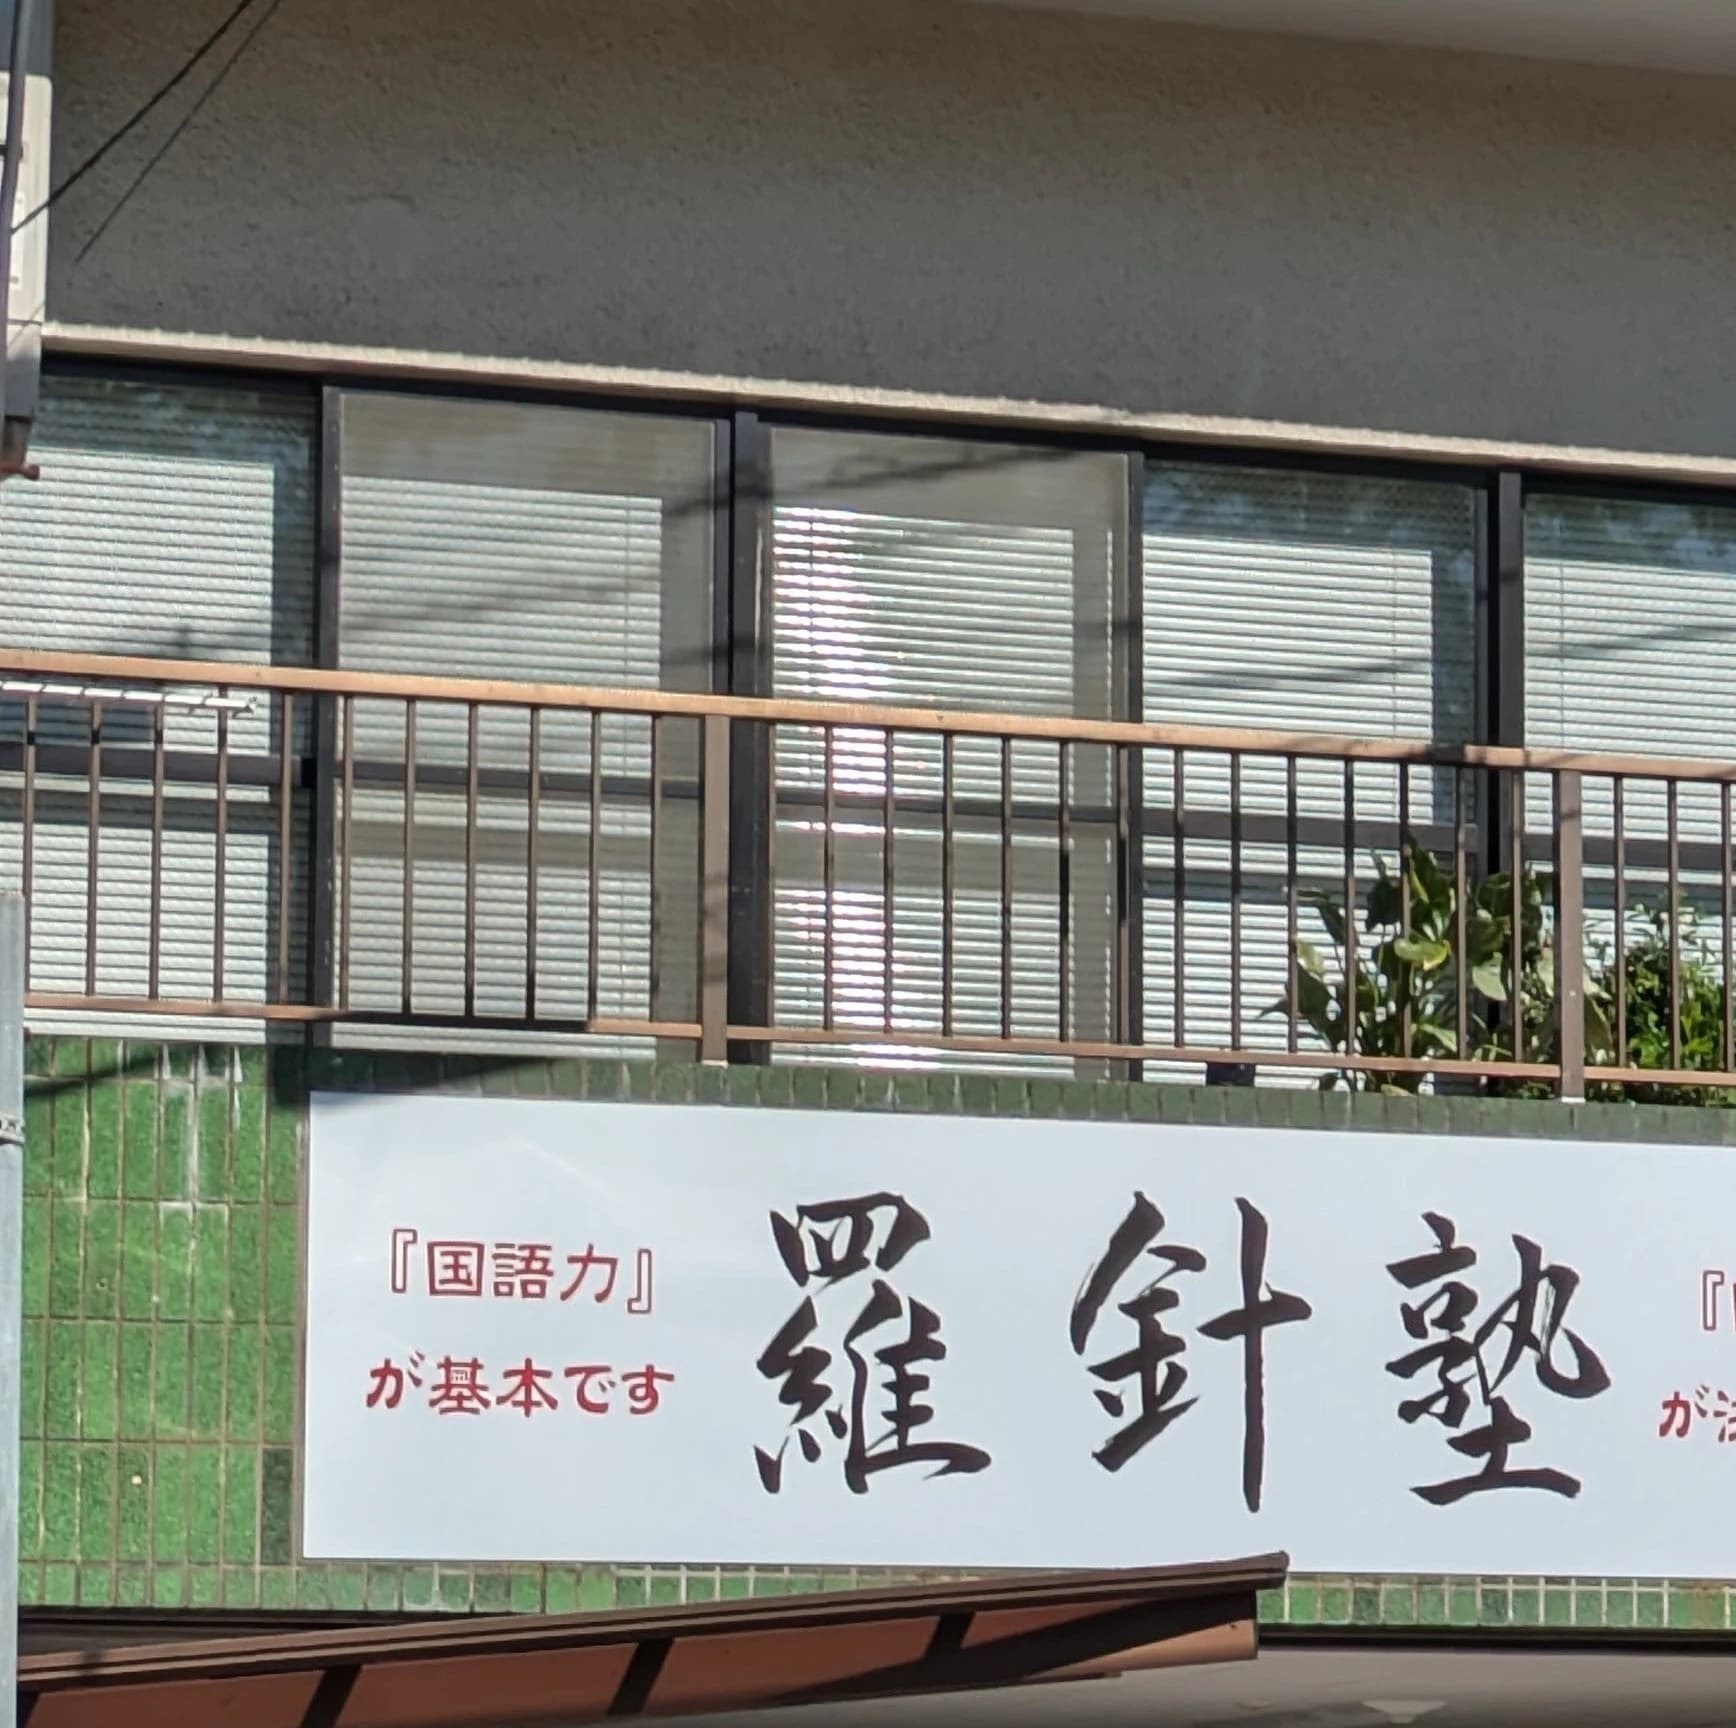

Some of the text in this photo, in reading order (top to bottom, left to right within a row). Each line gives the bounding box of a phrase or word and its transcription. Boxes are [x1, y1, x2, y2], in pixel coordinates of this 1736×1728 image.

[391, 1228, 653, 1314] 『国語力』
[366, 1352, 675, 1418] が基本です
[754, 1190, 1611, 1513] 羅針塾
